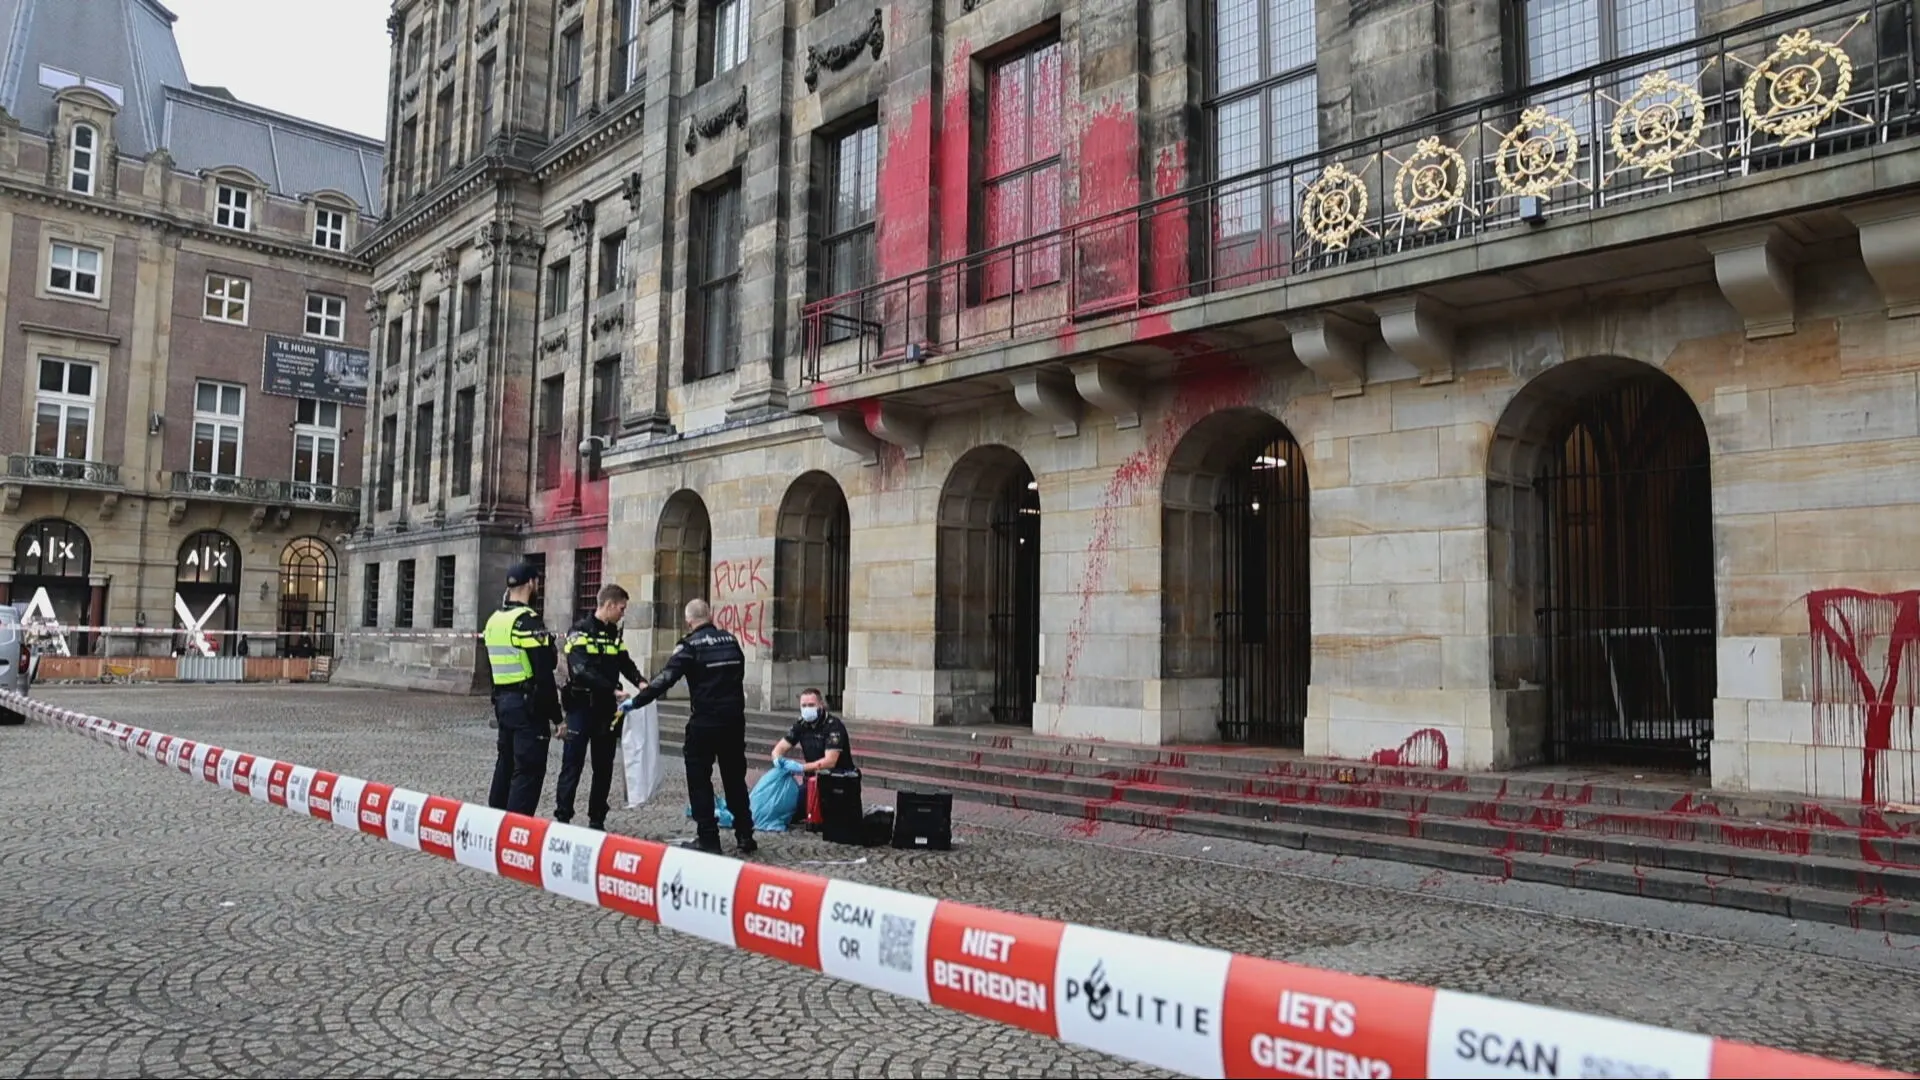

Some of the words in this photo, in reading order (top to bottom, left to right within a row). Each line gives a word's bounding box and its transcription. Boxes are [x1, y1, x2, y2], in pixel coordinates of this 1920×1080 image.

[278, 341, 289, 350] TE
[291, 343, 316, 355] HUUR
[714, 557, 767, 599] FUCK
[456, 824, 493, 853] POLITIE
[548, 836, 571, 855] SCAN
[551, 861, 563, 878] QR
[613, 850, 642, 875] NIET
[598, 873, 654, 907] BETREDEN
[661, 873, 728, 915] POLITIE
[757, 883, 793, 911] IETS
[744, 912, 805, 947] GEZIEN?
[831, 901, 875, 928] SCAN
[838, 935, 861, 961] QR
[961, 926, 1016, 963] NIET
[933, 958, 1047, 1013] BETREDEN
[1066, 966, 1211, 1036] POLITIE
[1277, 989, 1357, 1038] IETS
[1250, 1033, 1393, 1079] GEZIEN?
[1455, 1028, 1559, 1077] SCAN
